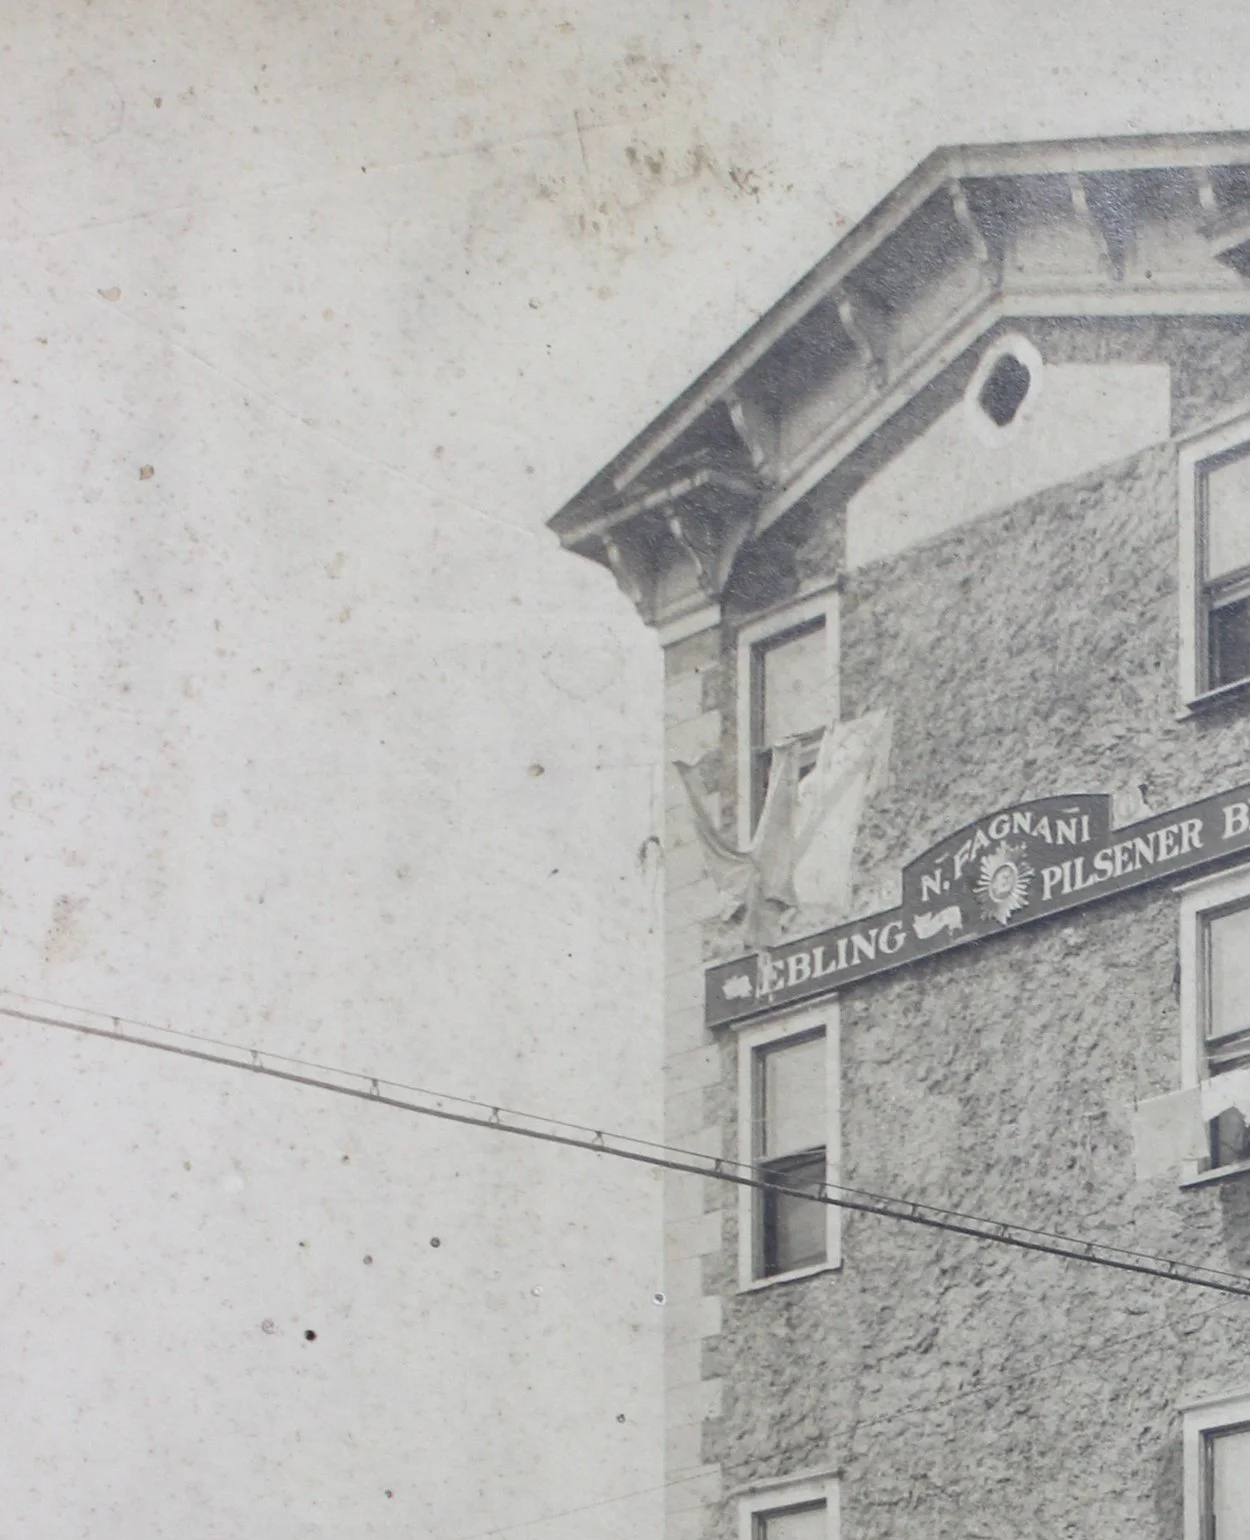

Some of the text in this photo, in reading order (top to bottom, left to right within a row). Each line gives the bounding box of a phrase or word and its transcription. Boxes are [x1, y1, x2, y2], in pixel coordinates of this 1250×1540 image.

[757, 920, 907, 997] EBLING
[1041, 818, 1204, 900] PILSENER
[921, 812, 1090, 901] N. FAGNANI
